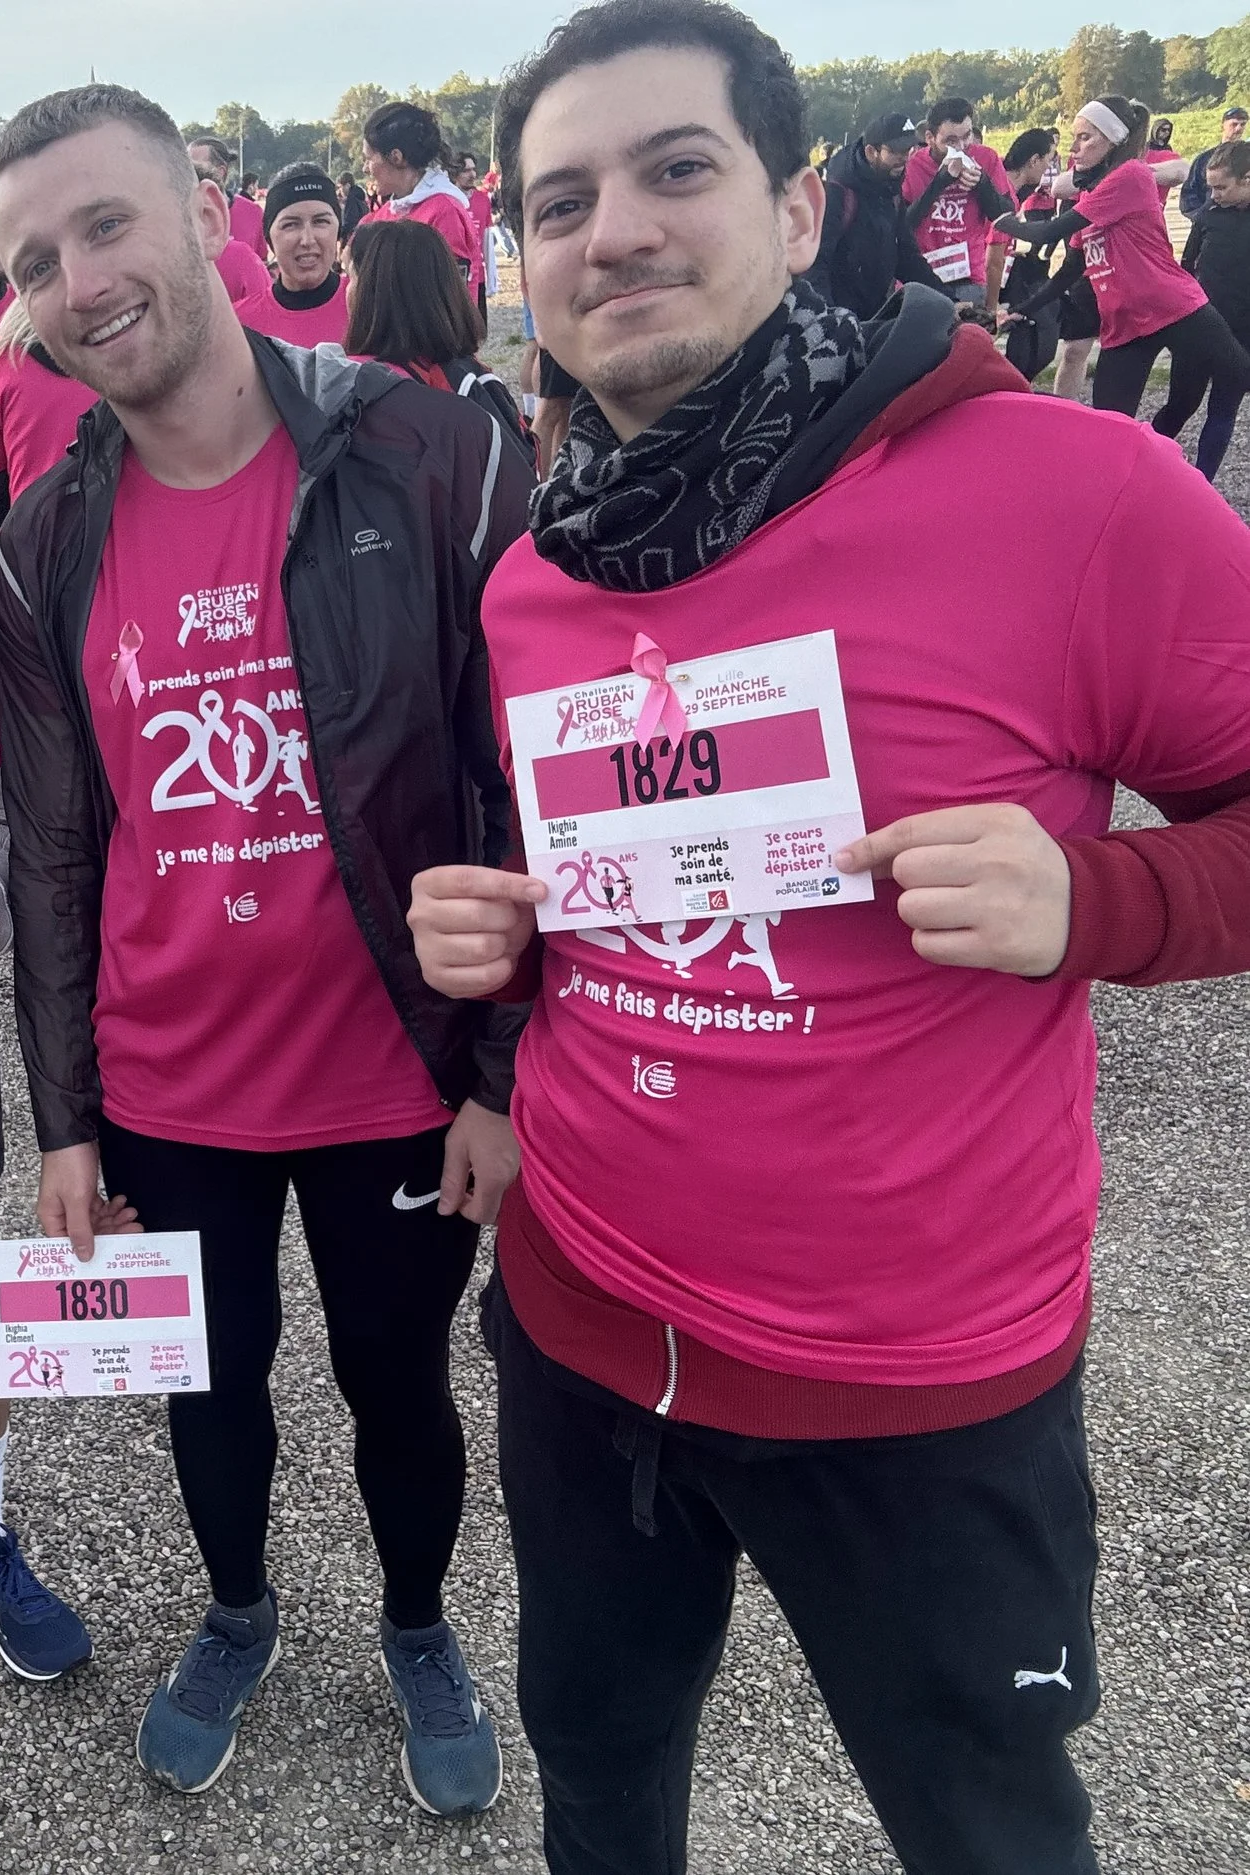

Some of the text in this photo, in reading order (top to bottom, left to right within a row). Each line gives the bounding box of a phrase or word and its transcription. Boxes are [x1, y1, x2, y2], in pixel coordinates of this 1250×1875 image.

[351, 539, 392, 557] Kalenji
[197, 582, 252, 598] Challenge
[198, 588, 259, 611] RUBAN
[199, 603, 247, 623] ROSE
[149, 669, 201, 697] prends
[204, 667, 235, 684] soin
[245, 658, 265, 674] ma
[268, 655, 293, 670] san
[717, 669, 744, 684] Lille
[574, 684, 627, 700] Challenge
[695, 676, 771, 701] DIMANCHE
[575, 689, 635, 712] RUBAN
[685, 686, 787, 716] 29 SEPTEMBRE
[577, 705, 623, 724] ROSE
[610, 730, 722, 807] 1829
[550, 836, 578, 850] Amine
[765, 827, 823, 846] Je cours
[156, 830, 324, 877] je me fais dépister
[670, 836, 730, 859] Je prends
[767, 842, 826, 859] me faire
[619, 853, 639, 863] ANS
[680, 853, 723, 871] soin de
[765, 854, 833, 877] dépister !
[675, 867, 735, 886] ma santé,
[785, 879, 819, 889] BANQUE
[775, 885, 820, 896] POPULAIRE
[558, 965, 816, 1035] je me fais dépister !
[32, 1247, 75, 1256] RUBAN
[33, 1256, 66, 1264] ROSE
[114, 1251, 162, 1261] DIMANCHE
[106, 1259, 172, 1269] 29 SEPTEMBRE
[55, 1279, 129, 1321] 1830
[103, 1345, 131, 1357] prends
[162, 1344, 184, 1352] cours
[165, 1352, 185, 1361] faire
[97, 1355, 126, 1365] soin de
